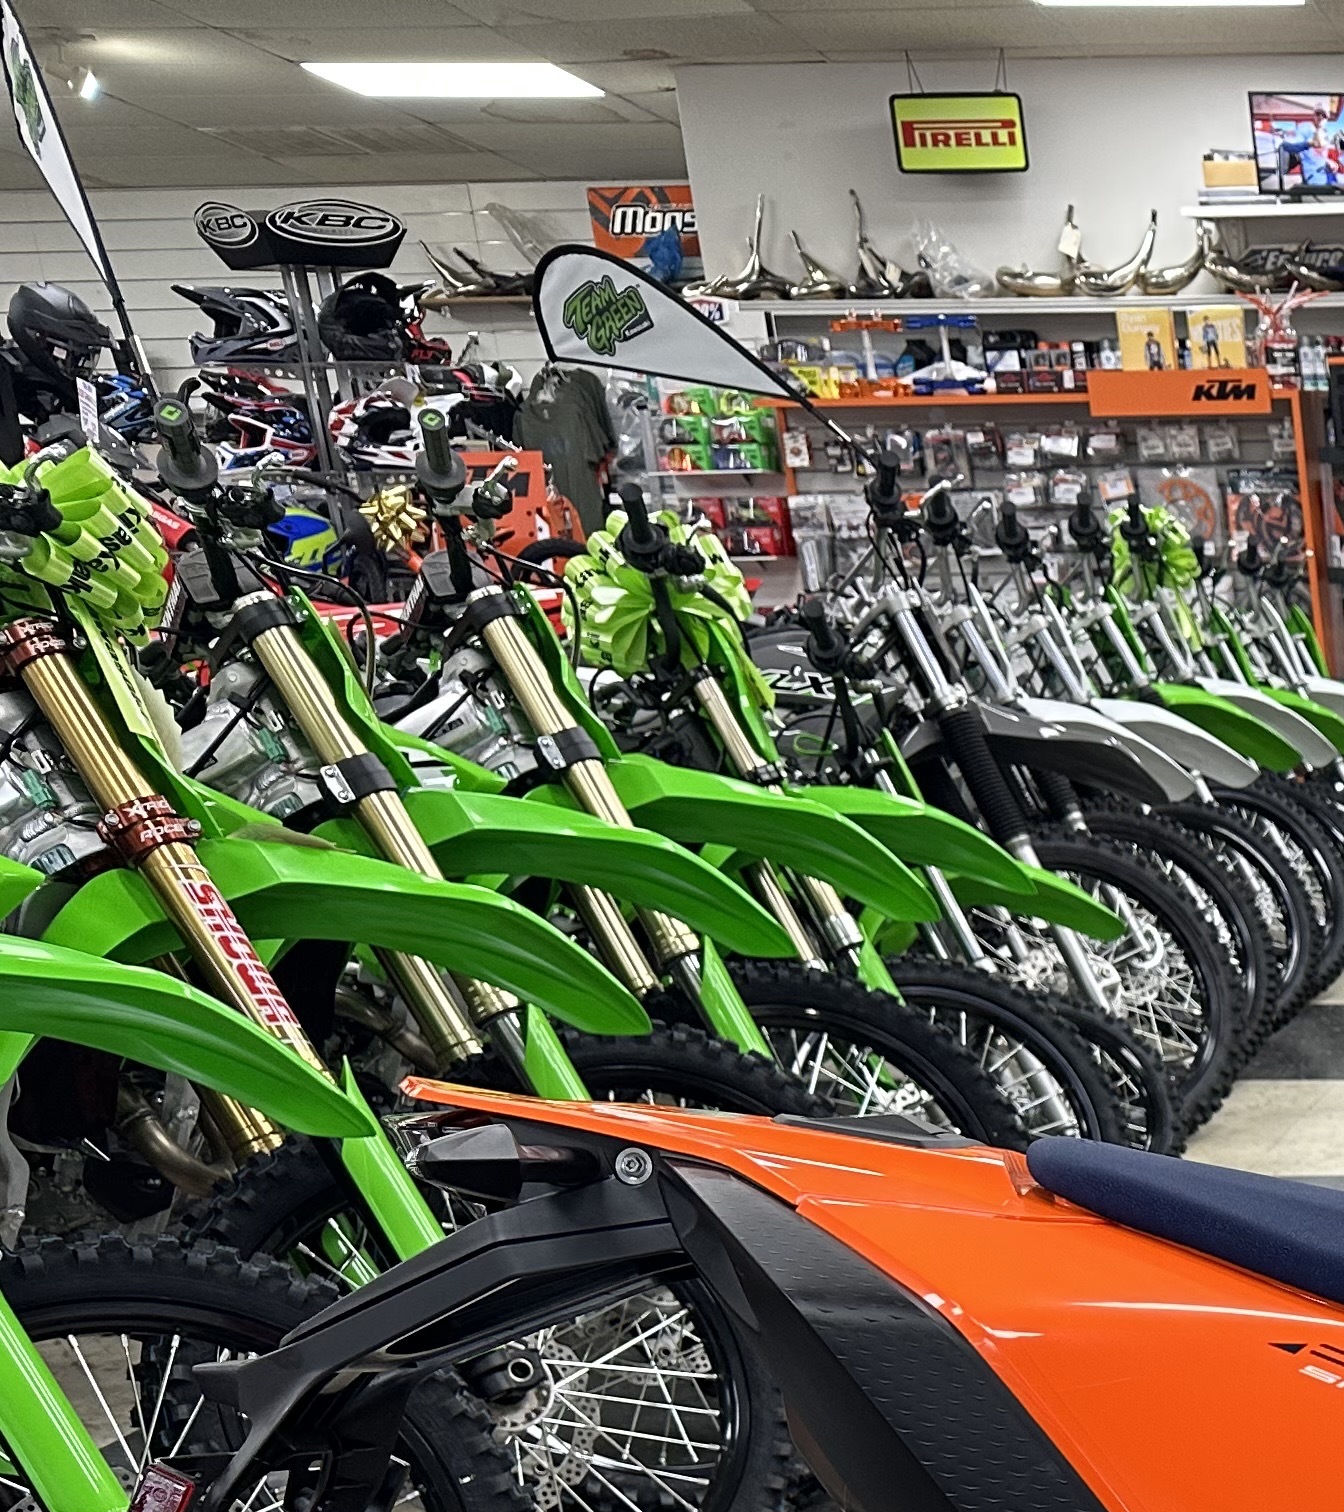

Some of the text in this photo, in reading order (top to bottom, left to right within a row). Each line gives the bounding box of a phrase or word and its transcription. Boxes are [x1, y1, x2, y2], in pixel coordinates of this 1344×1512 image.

[901, 119, 1017, 148] PIRELLI
[200, 214, 248, 234] KBC
[279, 211, 391, 230] KBC
[565, 283, 614, 333] TEAM
[590, 289, 645, 351] GREEN
[1192, 379, 1257, 401] KTM
